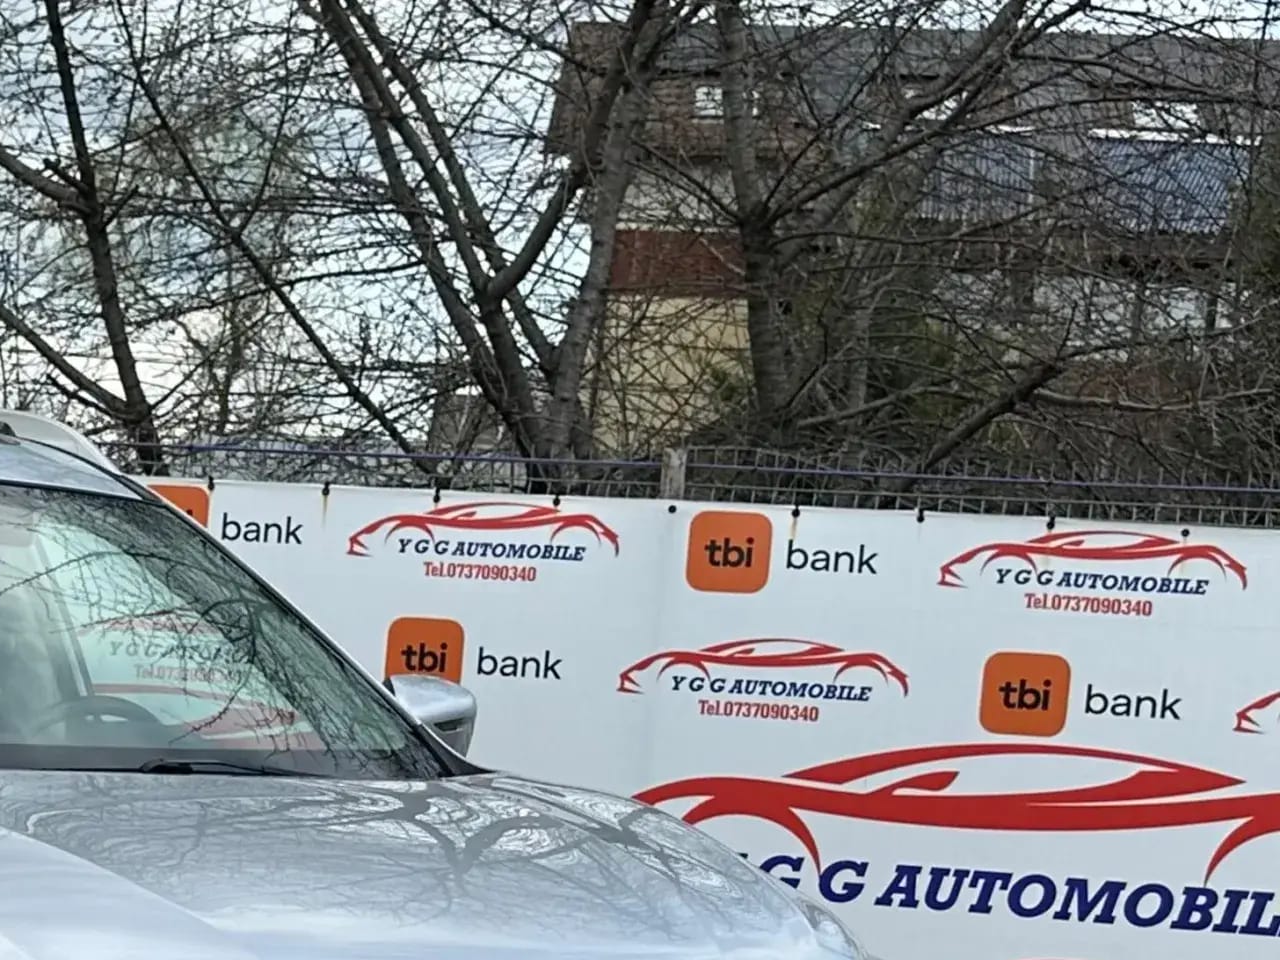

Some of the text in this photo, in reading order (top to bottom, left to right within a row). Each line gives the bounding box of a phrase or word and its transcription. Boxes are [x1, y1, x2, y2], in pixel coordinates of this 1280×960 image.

[222, 513, 302, 545] bank
[451, 542, 586, 562] AUTOMOBILE
[704, 537, 877, 575] tbi bank
[1056, 572, 1209, 596] AUTOMOBILE
[400, 642, 562, 681] tbi bank
[728, 679, 872, 703] AUTOMOBILE
[999, 679, 1182, 721] tbi bank
[873, 865, 1280, 938] AUTOMOBIL
